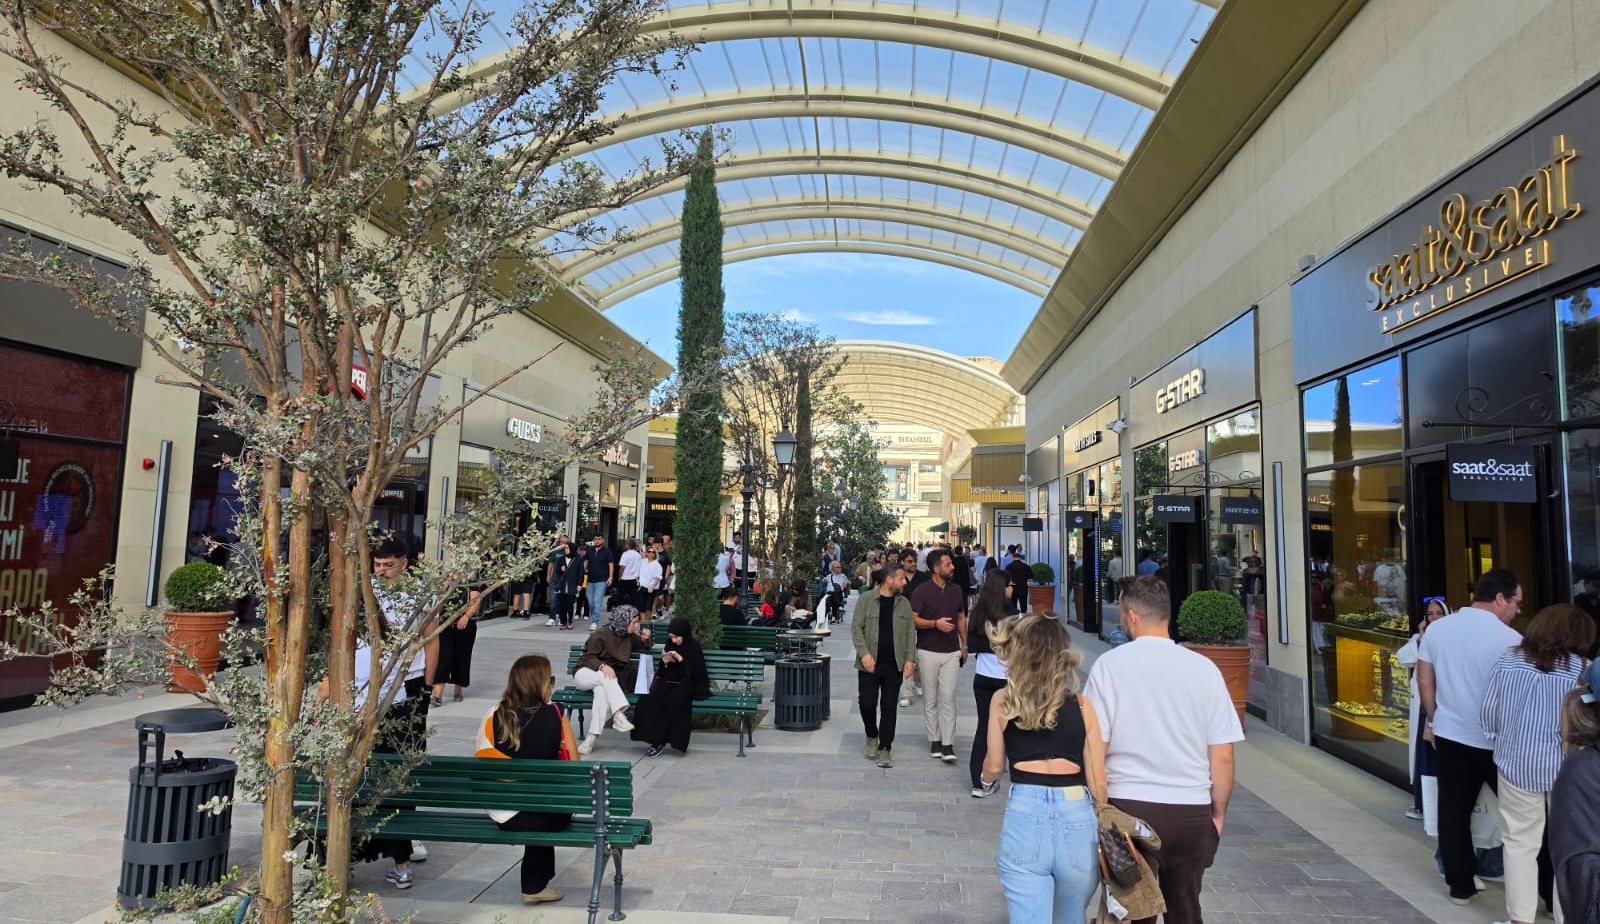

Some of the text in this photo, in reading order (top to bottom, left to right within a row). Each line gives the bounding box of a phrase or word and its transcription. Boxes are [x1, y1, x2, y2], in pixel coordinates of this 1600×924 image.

[1366, 134, 1582, 312] saat&saat
[1382, 246, 1535, 331] EXCLUSIVE
[1156, 368, 1202, 414] G-STAR
[508, 417, 541, 443] GUESS
[1168, 449, 1199, 472] G-STAR
[1452, 458, 1533, 477] saat&saat
